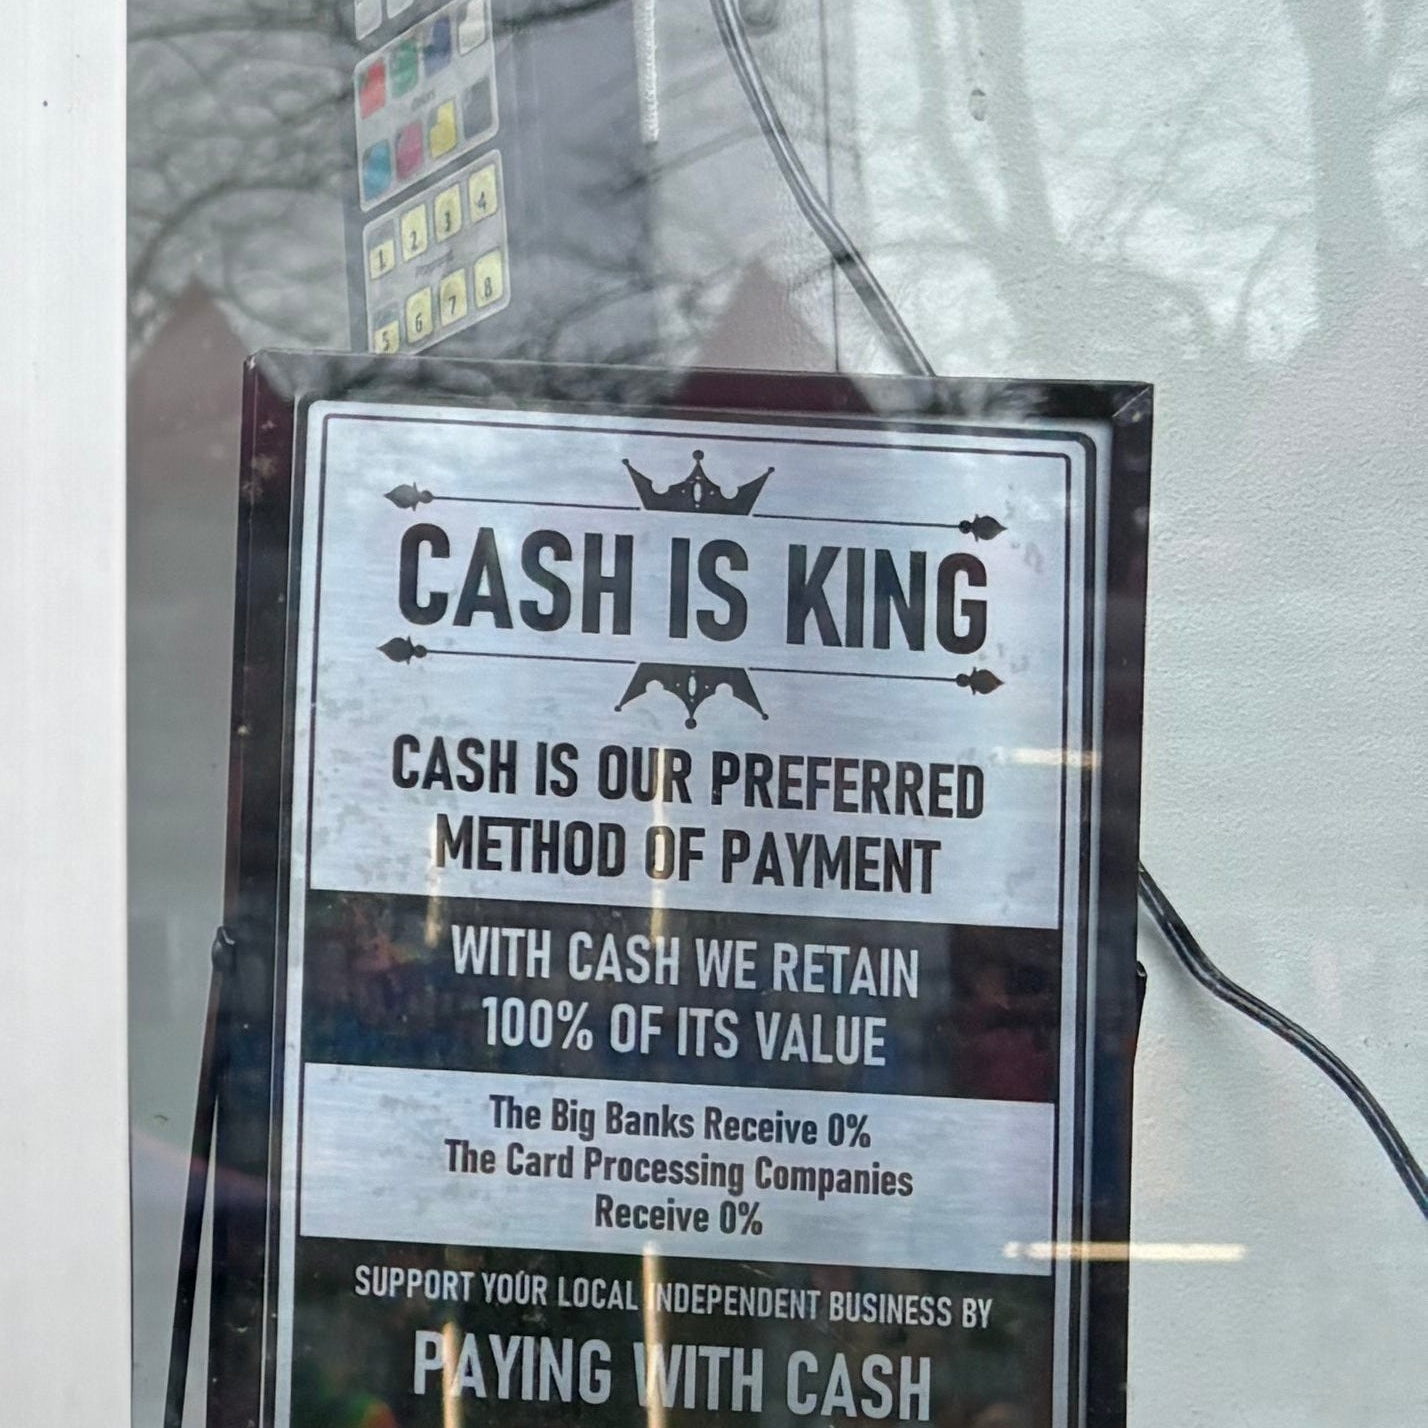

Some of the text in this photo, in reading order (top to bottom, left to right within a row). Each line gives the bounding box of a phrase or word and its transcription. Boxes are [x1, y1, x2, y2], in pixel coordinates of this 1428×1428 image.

[398, 523, 989, 654] CASH IS KING
[393, 734, 984, 820] CASH IS OUR PREFERRED
[436, 815, 942, 894] METHOD OF PAYMENT
[451, 925, 920, 998] WITH CASH WE RETAIN
[481, 997, 887, 1068] 100% OF ITS VALUE
[490, 1096, 870, 1148] The Big Banks Receive 0%
[444, 1140, 912, 1201] The Card Processing Companies
[595, 1194, 764, 1237] Receive 0%
[354, 1266, 474, 1302] SUPPORT
[480, 1268, 547, 1305] YOUR
[558, 1275, 638, 1310] LOCAL
[829, 1289, 952, 1327] BUSINESS
[961, 1296, 993, 1329] BY
[414, 1330, 931, 1422] PAYING WITH CASH
